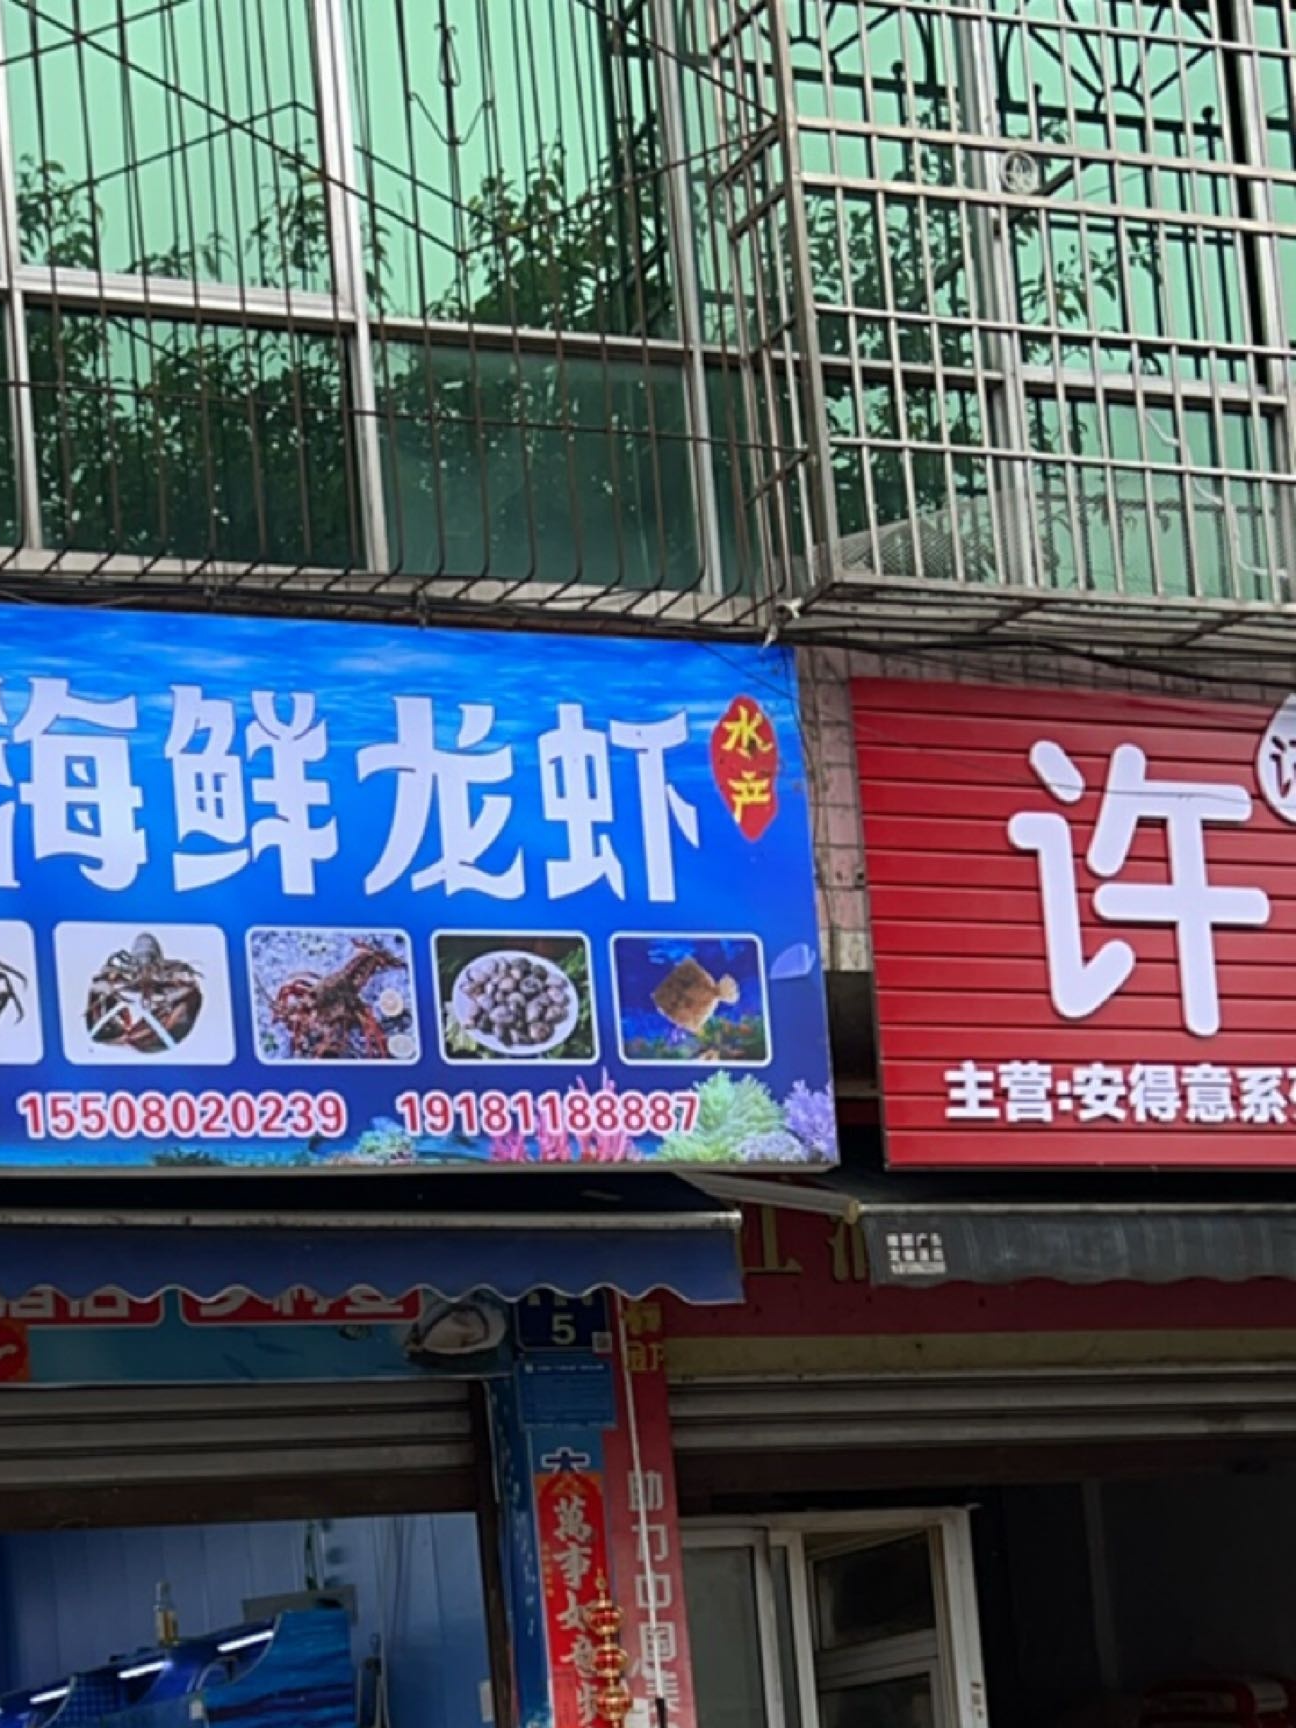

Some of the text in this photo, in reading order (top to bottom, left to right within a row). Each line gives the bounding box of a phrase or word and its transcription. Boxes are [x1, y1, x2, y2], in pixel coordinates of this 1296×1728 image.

[720, 705, 773, 822] 水产
[1007, 739, 1270, 1037] 许
[19, 1091, 347, 1139] 15508020239
[396, 1089, 700, 1138] 19181188887
[944, 1060, 1296, 1125] 主营:安得意系
[551, 1314, 576, 1346] 5
